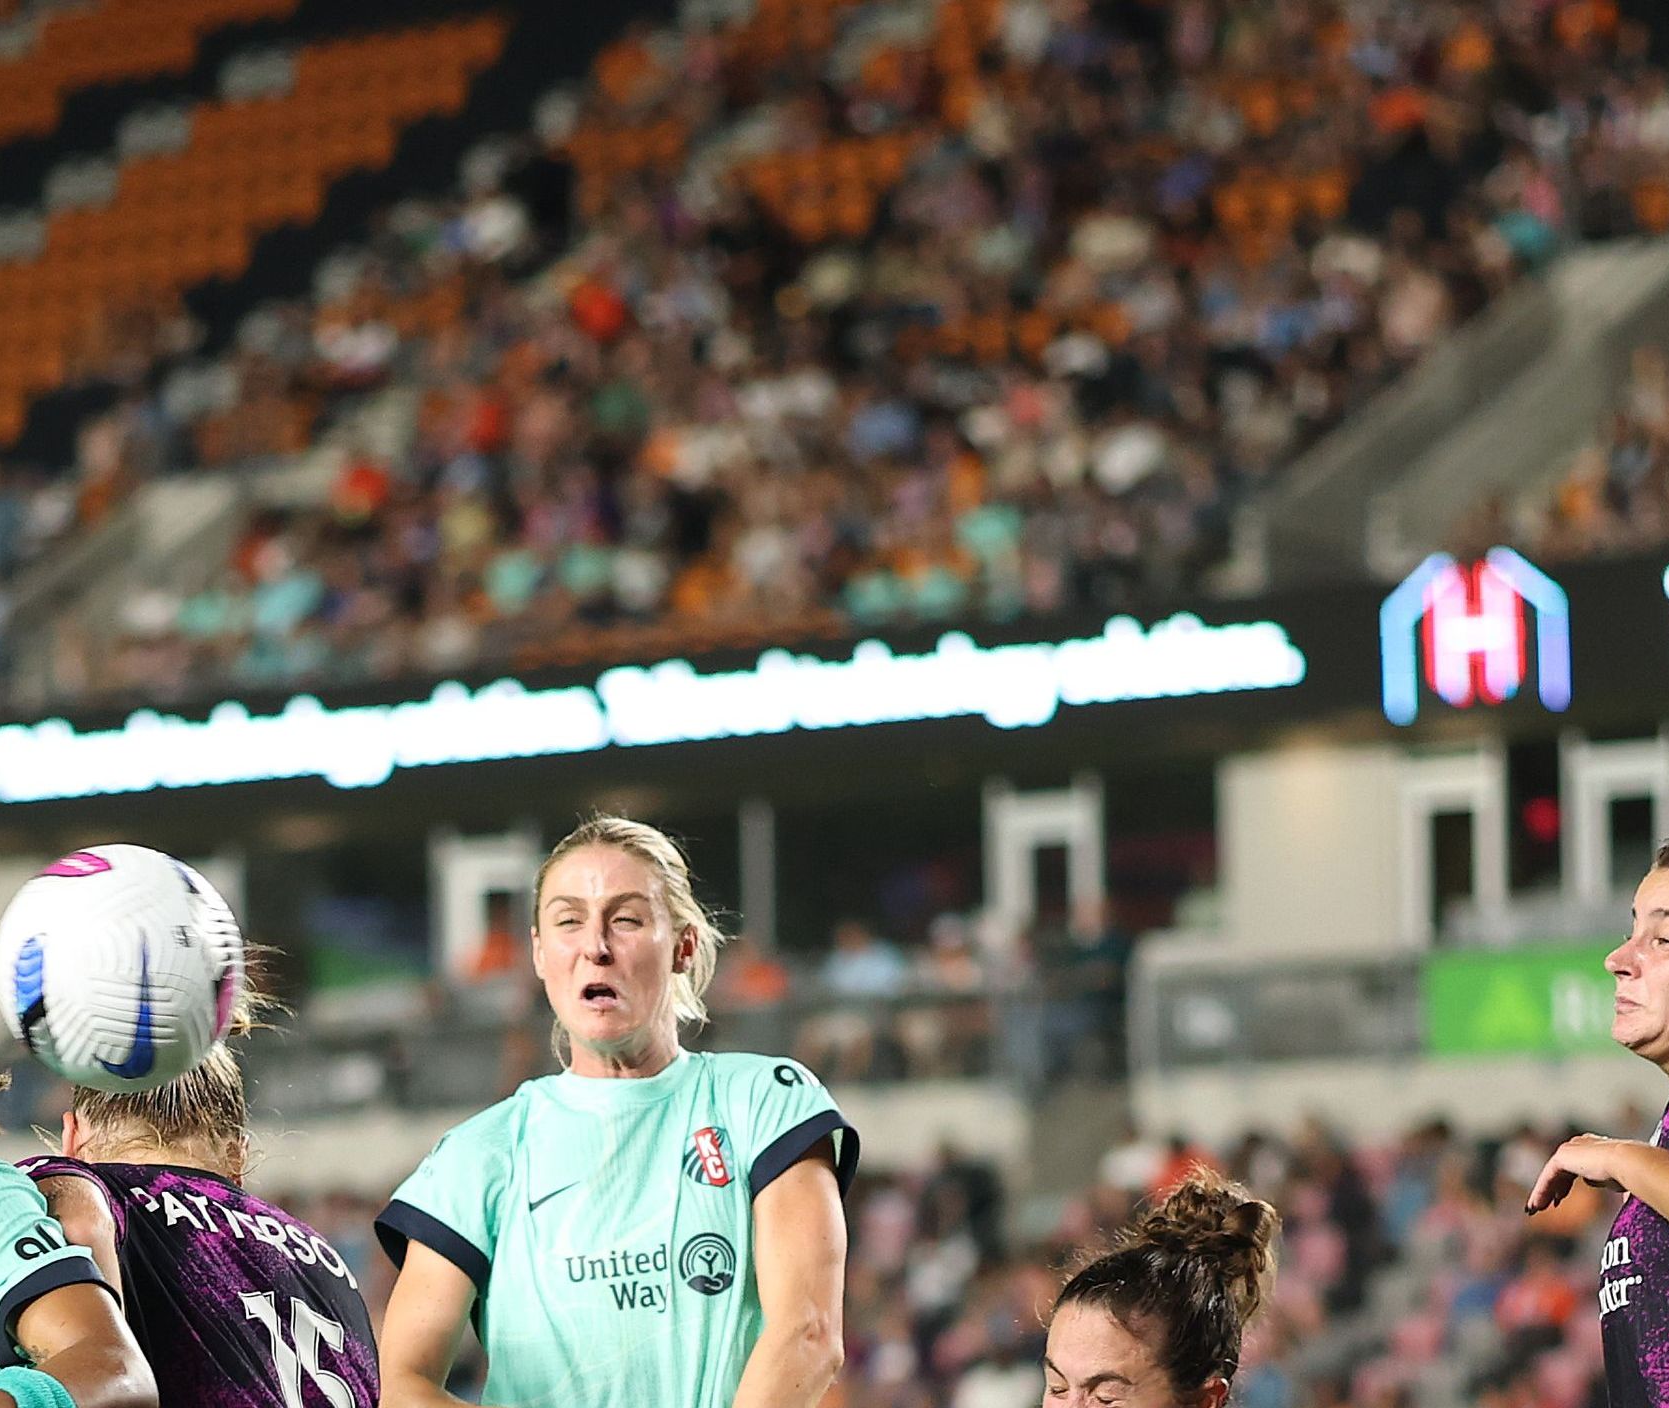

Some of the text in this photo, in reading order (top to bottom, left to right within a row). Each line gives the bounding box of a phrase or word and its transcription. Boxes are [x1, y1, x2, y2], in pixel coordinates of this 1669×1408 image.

[564, 1243, 668, 1283] United
[1599, 1235, 1632, 1276] on
[608, 1280, 670, 1314] Way
